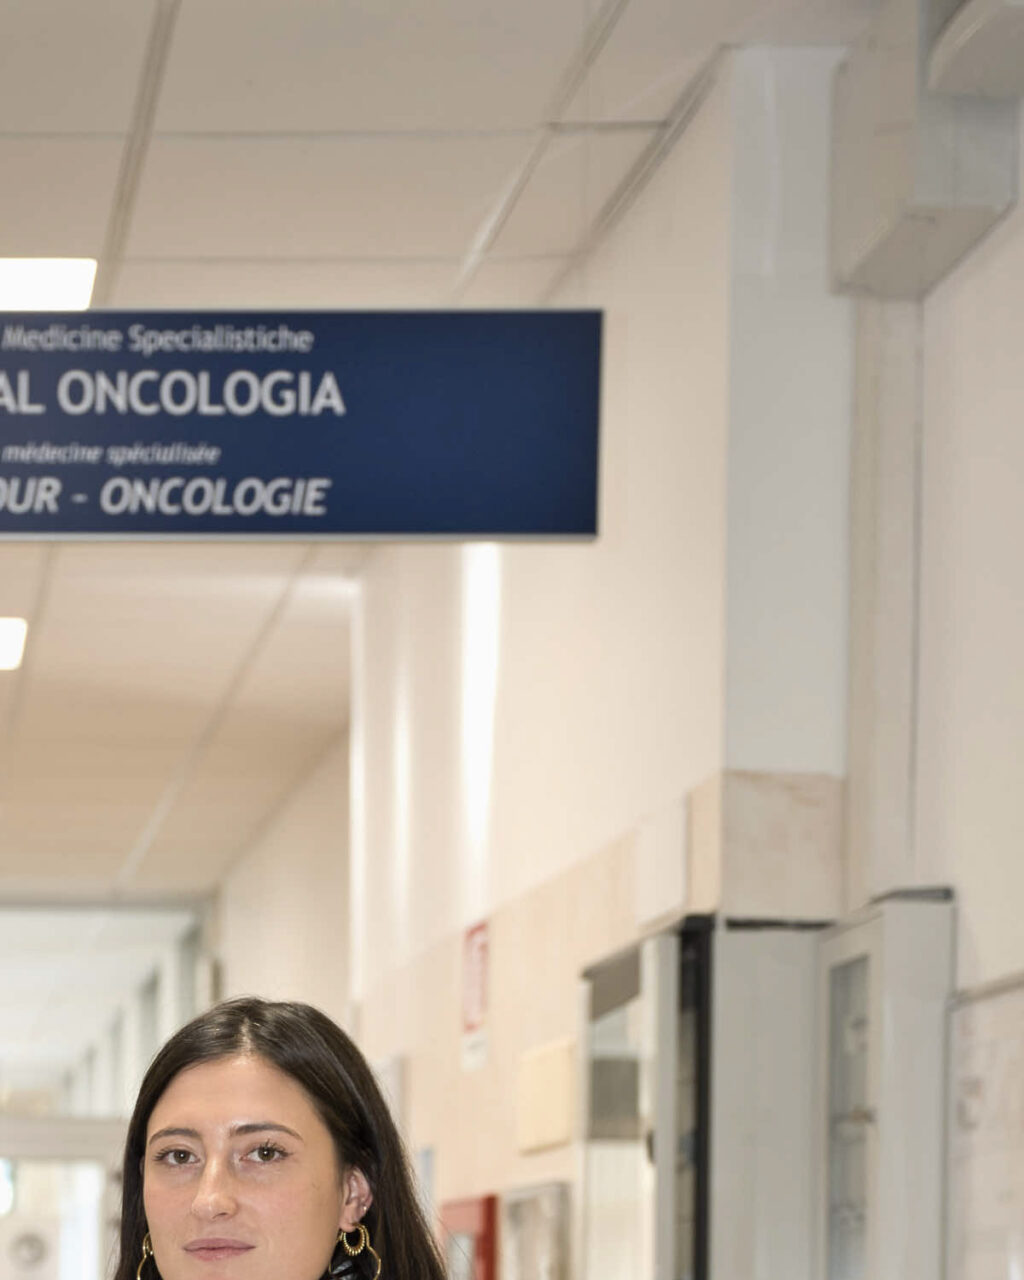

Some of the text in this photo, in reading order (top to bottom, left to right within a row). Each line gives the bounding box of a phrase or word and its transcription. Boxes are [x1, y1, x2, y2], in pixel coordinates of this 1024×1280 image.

[1, 323, 123, 351] Medicine
[128, 324, 315, 355] Specialistiche
[57, 370, 347, 416] ONCOLOGIA
[1, 442, 103, 463] médecine
[100, 477, 332, 516] ONCOLOGIE
